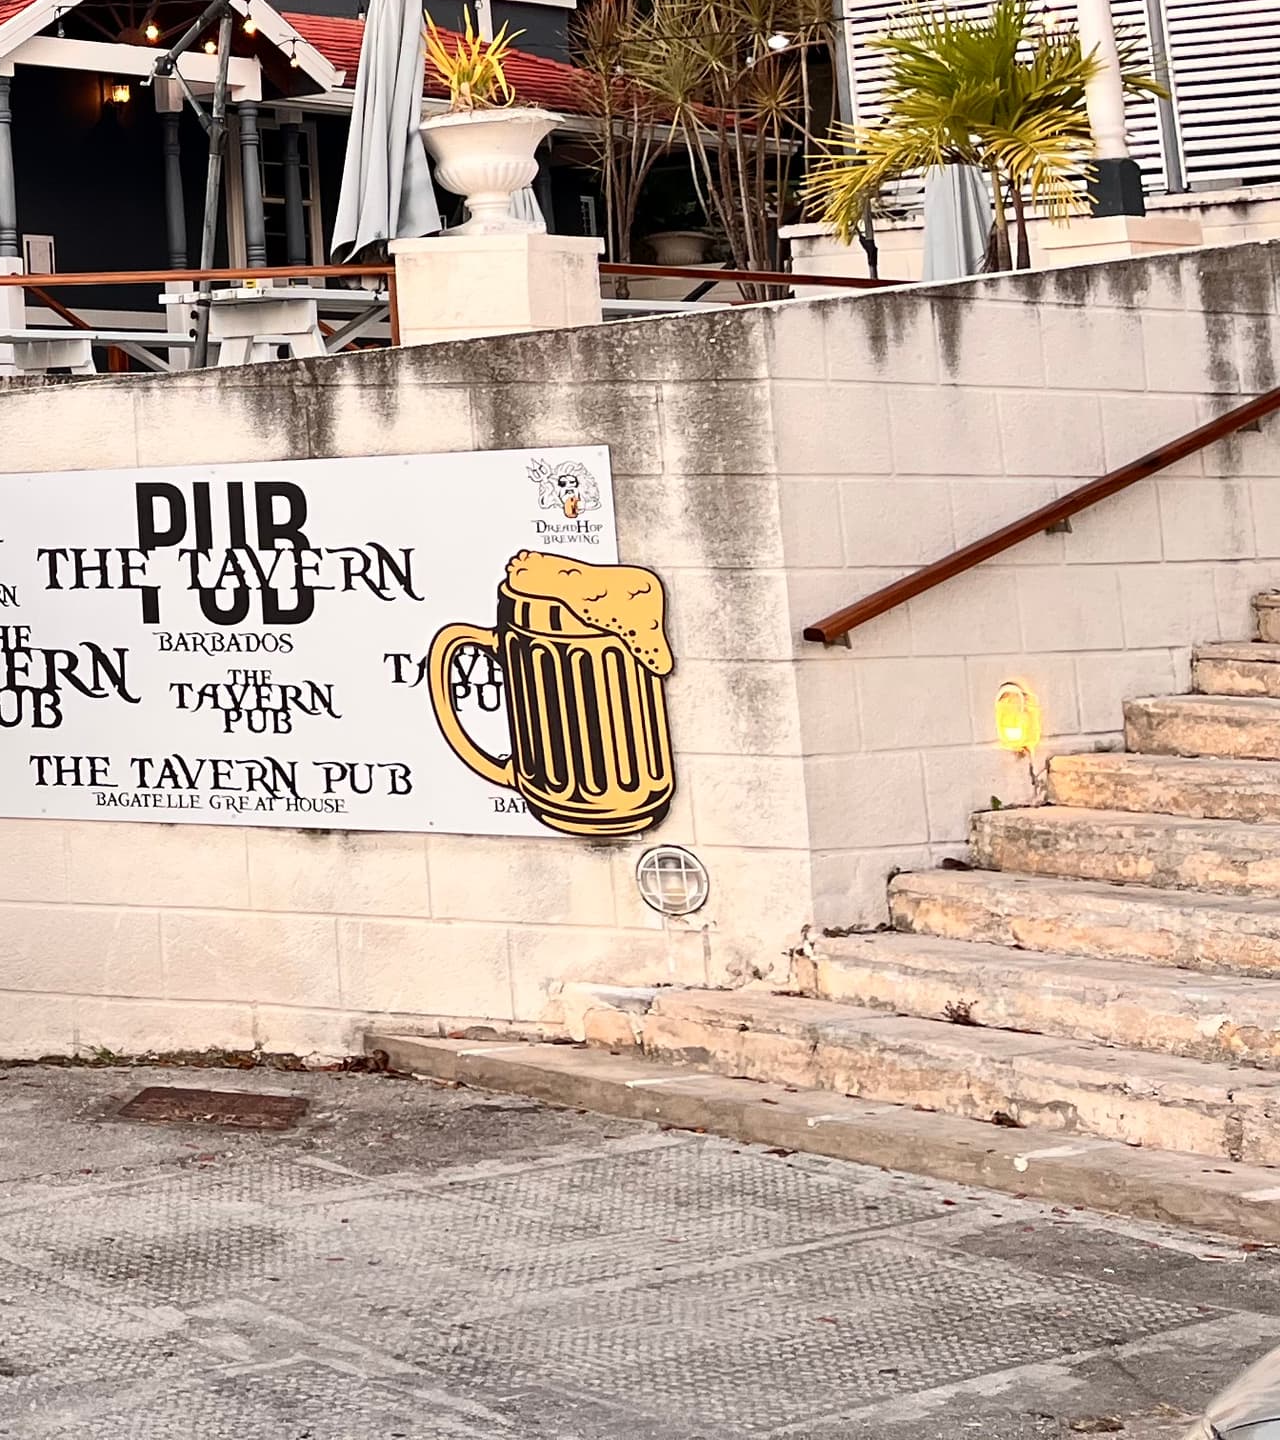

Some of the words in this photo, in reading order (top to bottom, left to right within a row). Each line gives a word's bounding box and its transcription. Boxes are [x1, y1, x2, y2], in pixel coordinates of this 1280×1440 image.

[541, 534, 600, 545] BREWING
[135, 481, 315, 625] PUB
[37, 547, 161, 591] THE
[178, 542, 425, 601] TAVERN
[152, 631, 294, 656] BARBADOS
[228, 669, 271, 685] THE
[169, 680, 342, 719] TAVERN
[223, 709, 293, 734] PUB
[29, 755, 118, 788] THE
[130, 753, 306, 799] TAVERN
[313, 761, 412, 795] PUB
[92, 791, 204, 810] BAGATELLE
[209, 795, 277, 813] GREAT
[285, 796, 349, 814] HOUSE
